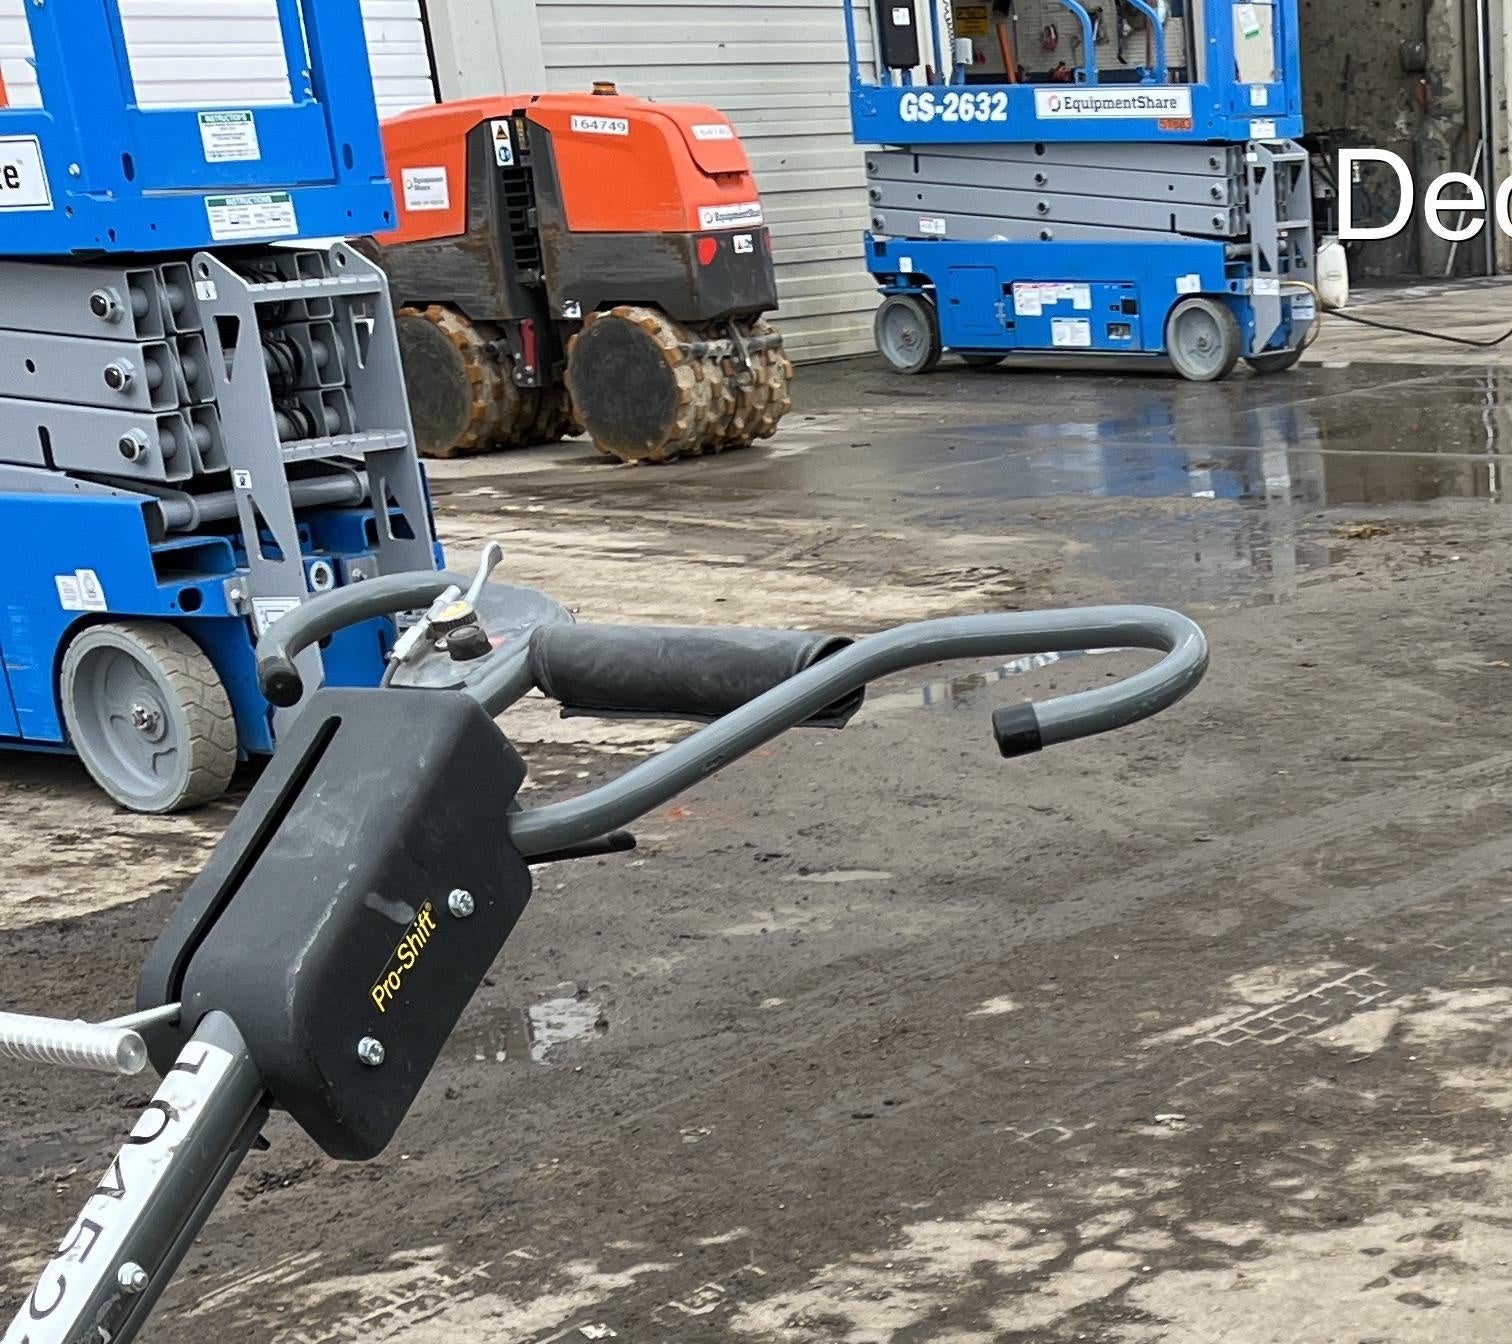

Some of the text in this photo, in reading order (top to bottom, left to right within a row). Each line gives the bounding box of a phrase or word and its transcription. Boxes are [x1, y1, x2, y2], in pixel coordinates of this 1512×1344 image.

[900, 92, 1008, 122] GS-2632
[1064, 95, 1178, 111] EquipmentShare
[573, 118, 627, 133] 164749
[371, 909, 437, 1013] Pro-Shift
